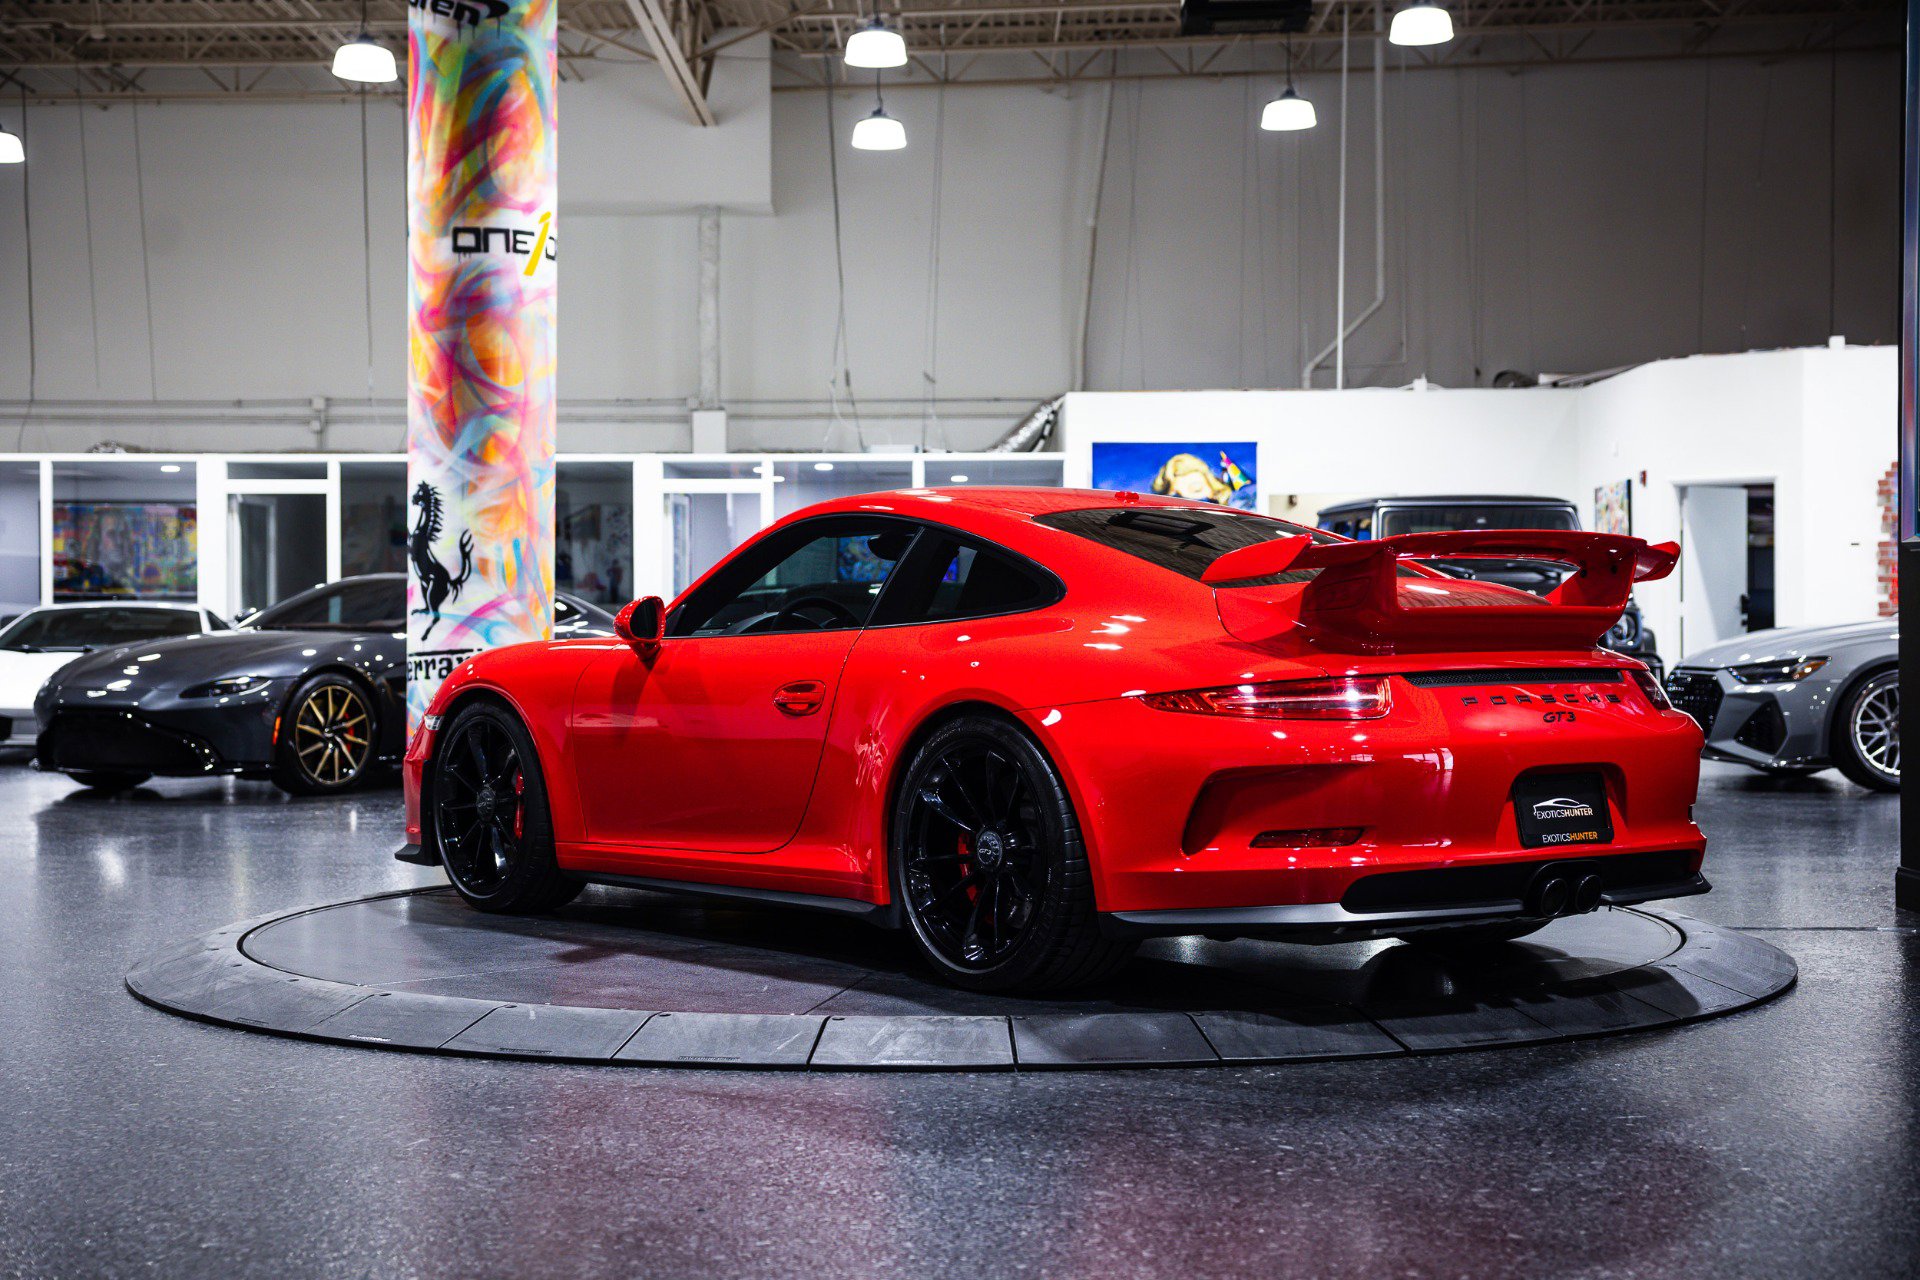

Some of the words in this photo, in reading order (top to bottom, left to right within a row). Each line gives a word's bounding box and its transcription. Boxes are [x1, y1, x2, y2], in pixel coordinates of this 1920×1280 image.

[1460, 693, 1621, 707] PORSCHE
[1543, 711, 1576, 723] GT3
[1536, 807, 1594, 820] EXOTICSHUNTER
[1542, 831, 1598, 843] EXOTICSHUNTER
